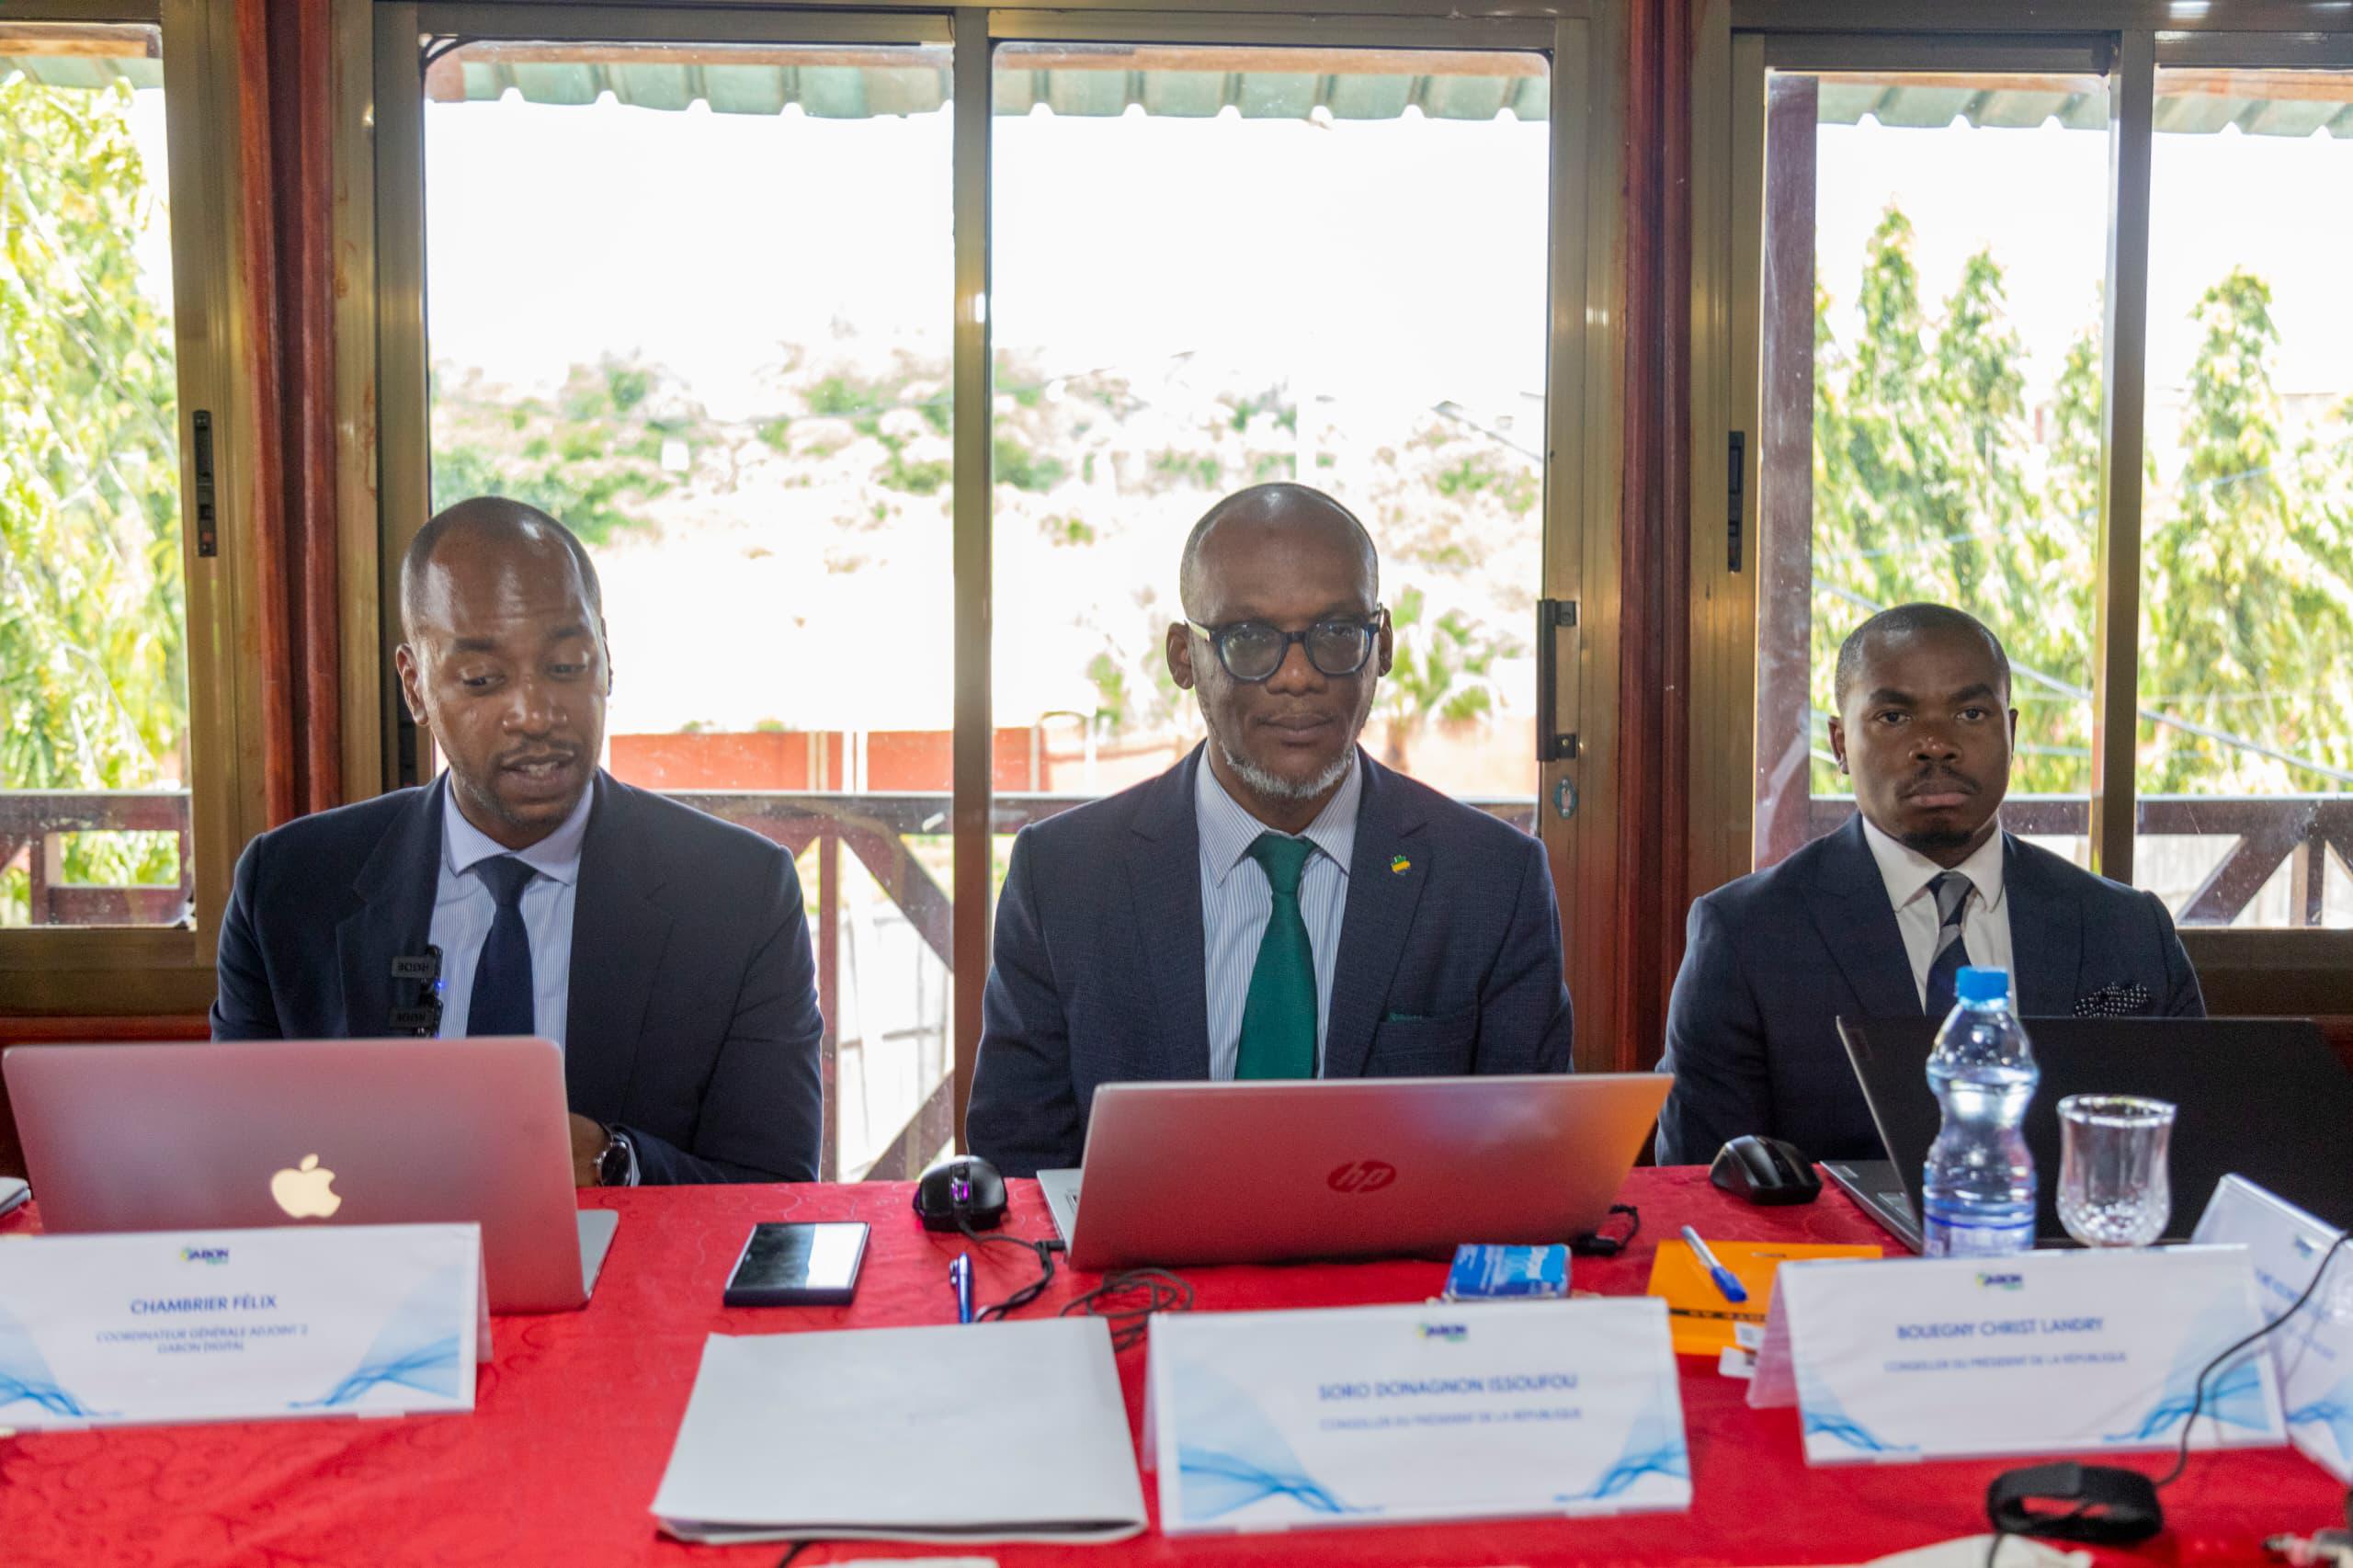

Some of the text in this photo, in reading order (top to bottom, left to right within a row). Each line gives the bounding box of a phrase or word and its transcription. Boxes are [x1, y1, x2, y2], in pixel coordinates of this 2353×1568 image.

[130, 1292, 277, 1314] CHAMBRIER FÉLIX
[1980, 1319, 2037, 1335] CHRIST
[2041, 1316, 2104, 1333] LANDRY
[1319, 1381, 1370, 1401] SORO
[1489, 1372, 1578, 1392] ISSOUFOU
